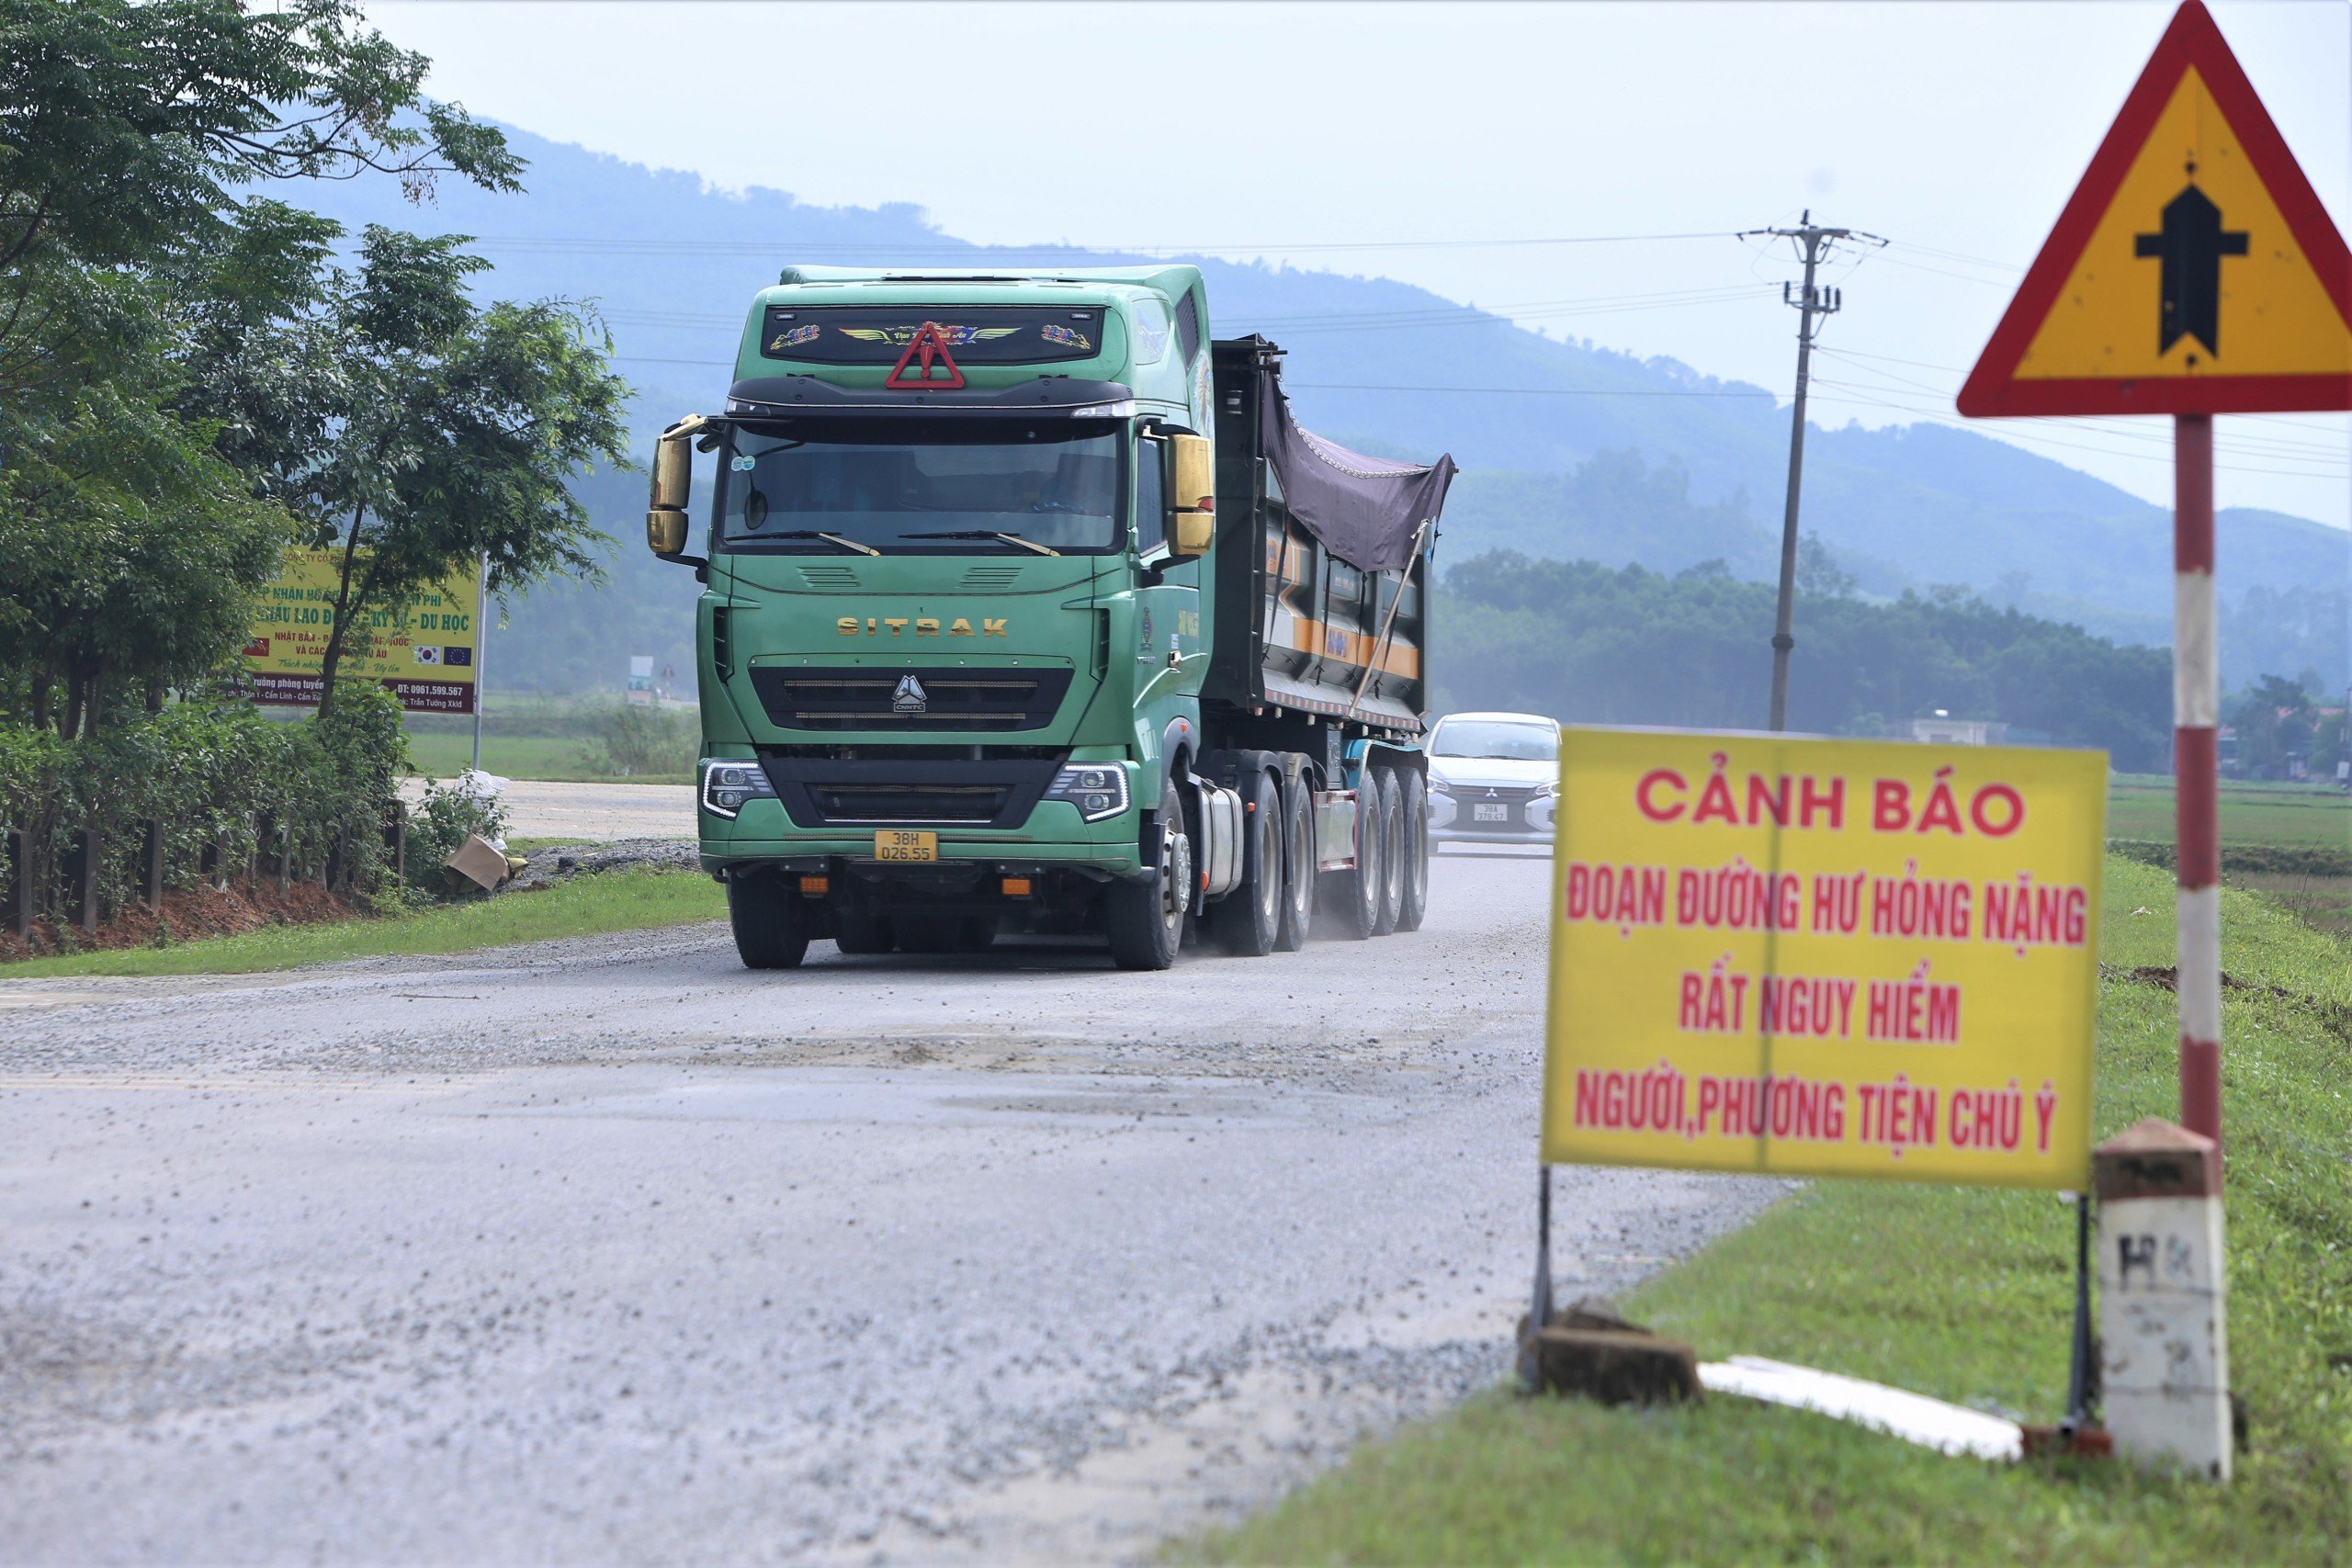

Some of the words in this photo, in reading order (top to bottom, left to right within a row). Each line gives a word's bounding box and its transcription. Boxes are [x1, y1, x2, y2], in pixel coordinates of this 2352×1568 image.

[294, 607, 320, 625] LAO
[420, 613, 438, 629] DU
[441, 613, 470, 635] HỌC
[275, 630, 295, 643] NHẬT
[837, 617, 1008, 637] SITRAK
[296, 644, 307, 655] VÀ
[411, 685, 463, 696] 0961.599.567
[1634, 750, 1846, 831] CẢNH
[1871, 765, 2027, 840] BÁO
[893, 832, 919, 845] 38H
[882, 847, 931, 861] 026.55
[1566, 863, 1668, 937] ĐOẠN
[1676, 857, 1802, 932] ĐƯỜNG
[1811, 870, 1867, 935] HƯ
[1871, 859, 1973, 941] HỎNG
[1982, 873, 2087, 956] NẶNG
[1678, 953, 1749, 1033] RẤT
[1758, 976, 1858, 1038] NGUY
[1866, 958, 1962, 1043] HIỂM
[1857, 1073, 1939, 1157] TIỆN
[1948, 1080, 2023, 1152] CHÚ
[2034, 1081, 2057, 1153] Ý
